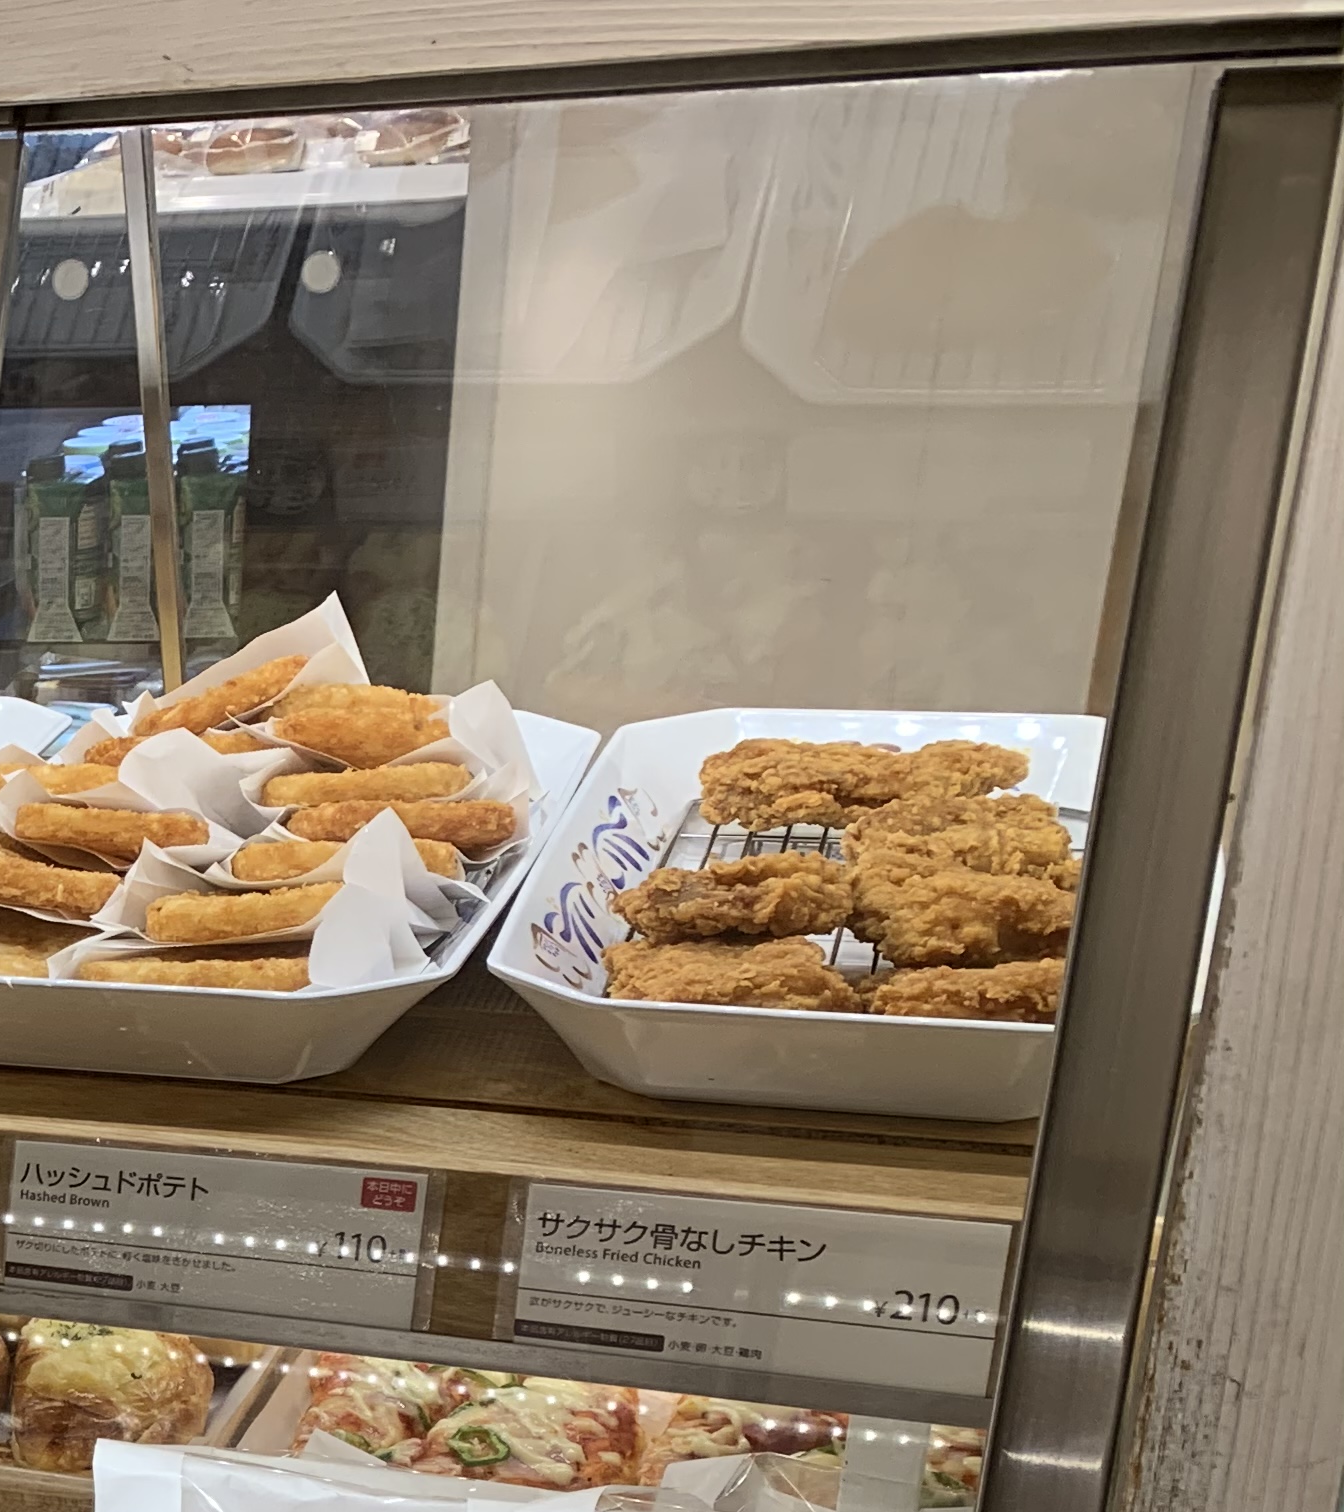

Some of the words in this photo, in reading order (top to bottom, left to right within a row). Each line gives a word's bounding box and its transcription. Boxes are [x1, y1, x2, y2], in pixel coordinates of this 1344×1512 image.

[19, 1163, 210, 1202] ハッシュドポテト
[366, 1181, 413, 1195] 本日中に
[19, 1189, 67, 1204] Hashed
[69, 1193, 111, 1209] Brown
[372, 1193, 406, 1208] どうぞ
[537, 1211, 827, 1262] サクサク骨なしチキン
[535, 1241, 599, 1260] Boneless
[602, 1248, 640, 1264] Fried
[642, 1252, 702, 1271] Chicken
[874, 1290, 987, 1326] ¥210+
